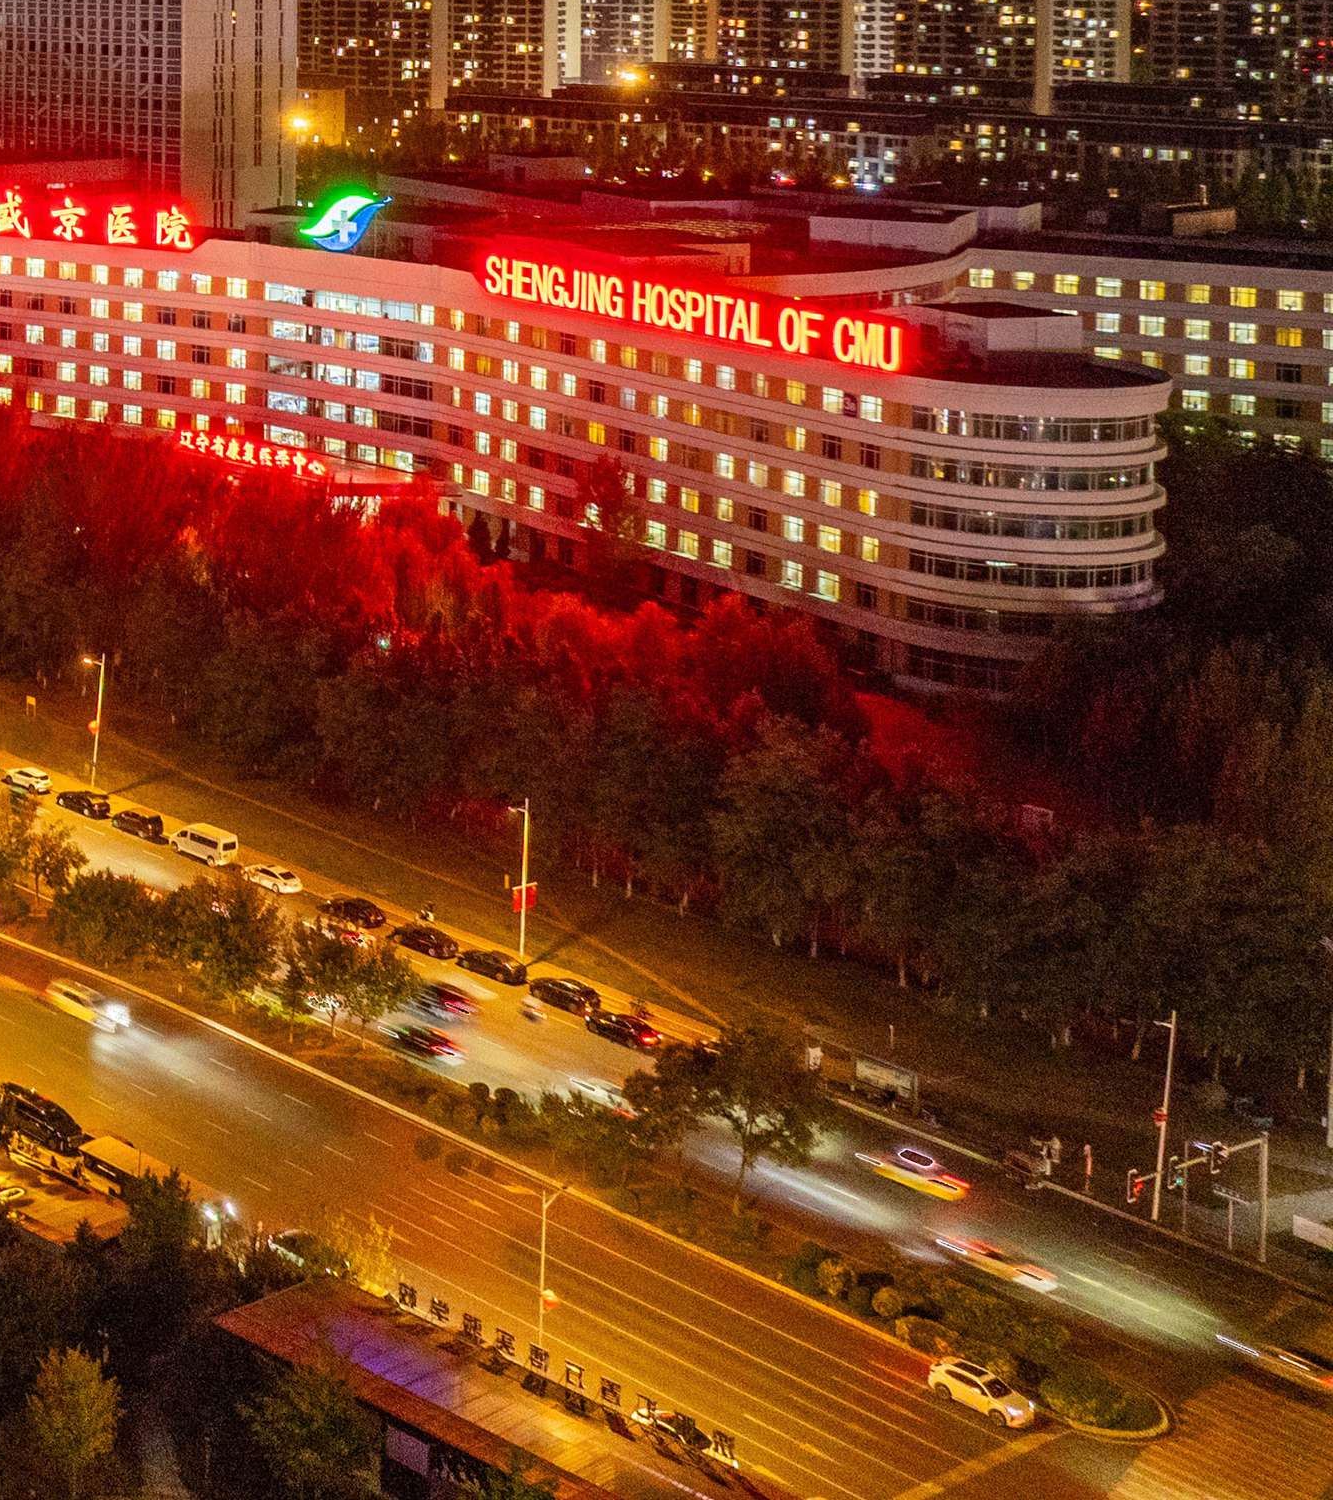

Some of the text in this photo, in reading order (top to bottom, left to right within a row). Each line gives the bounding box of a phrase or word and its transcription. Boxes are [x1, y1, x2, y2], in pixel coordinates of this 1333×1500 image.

[485, 255, 902, 371] SHENGJING HOSPITAL OF CMU
